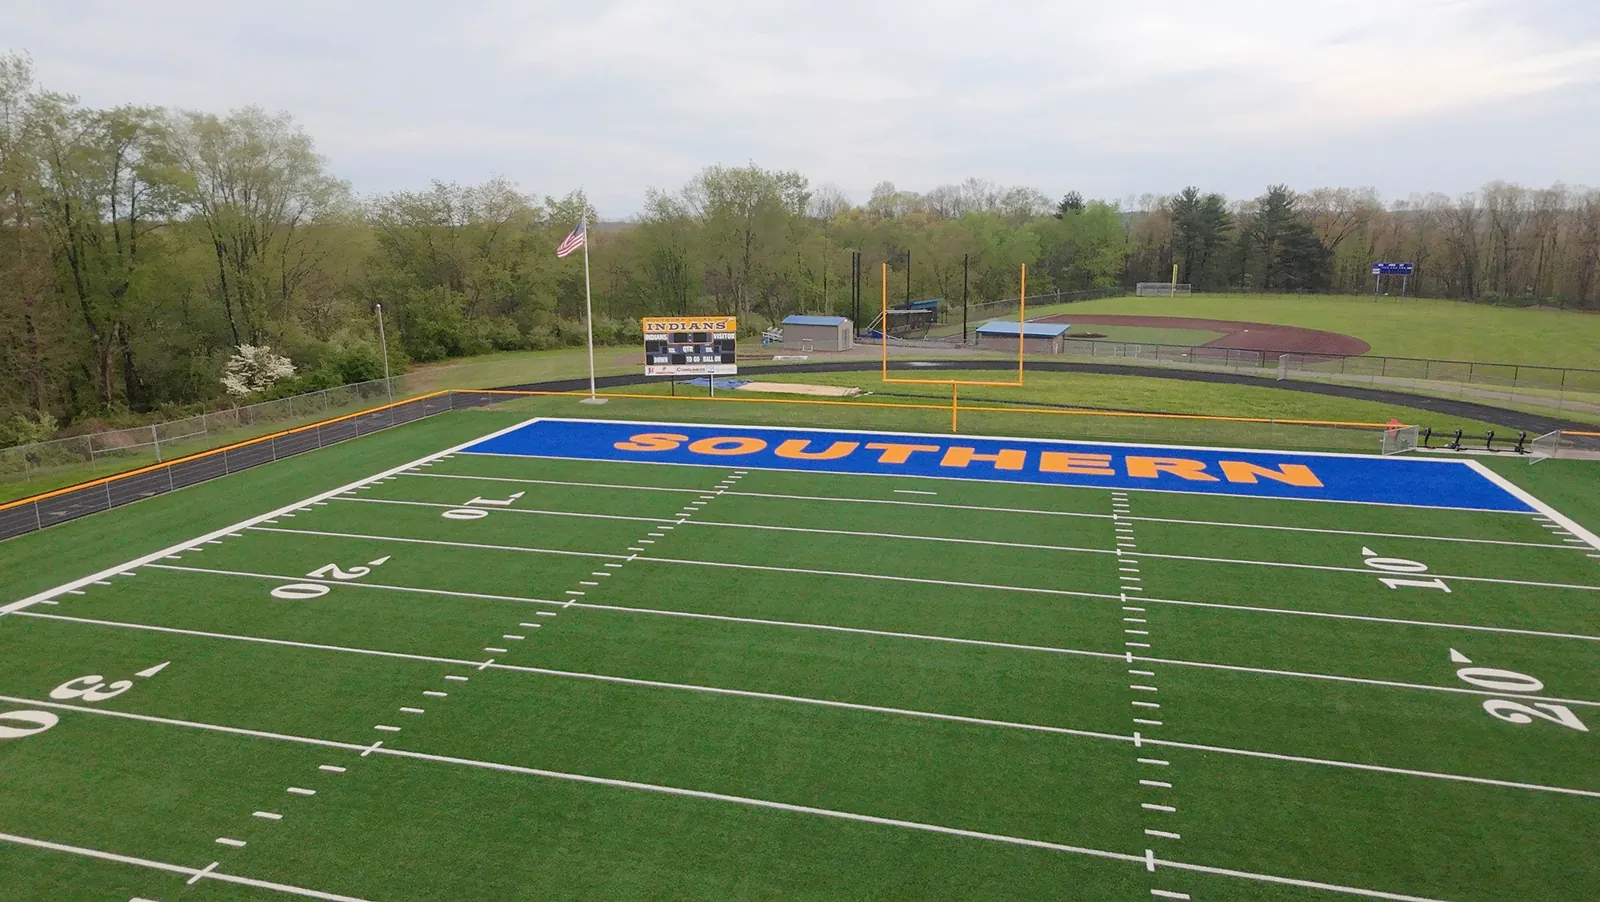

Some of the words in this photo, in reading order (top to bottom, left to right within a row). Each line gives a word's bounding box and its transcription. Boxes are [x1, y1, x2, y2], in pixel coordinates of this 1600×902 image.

[647, 322, 727, 331] INDIANS
[613, 432, 1324, 488] SOUTHERN
[1363, 556, 1452, 593] 10
[1456, 667, 1590, 732] 20
